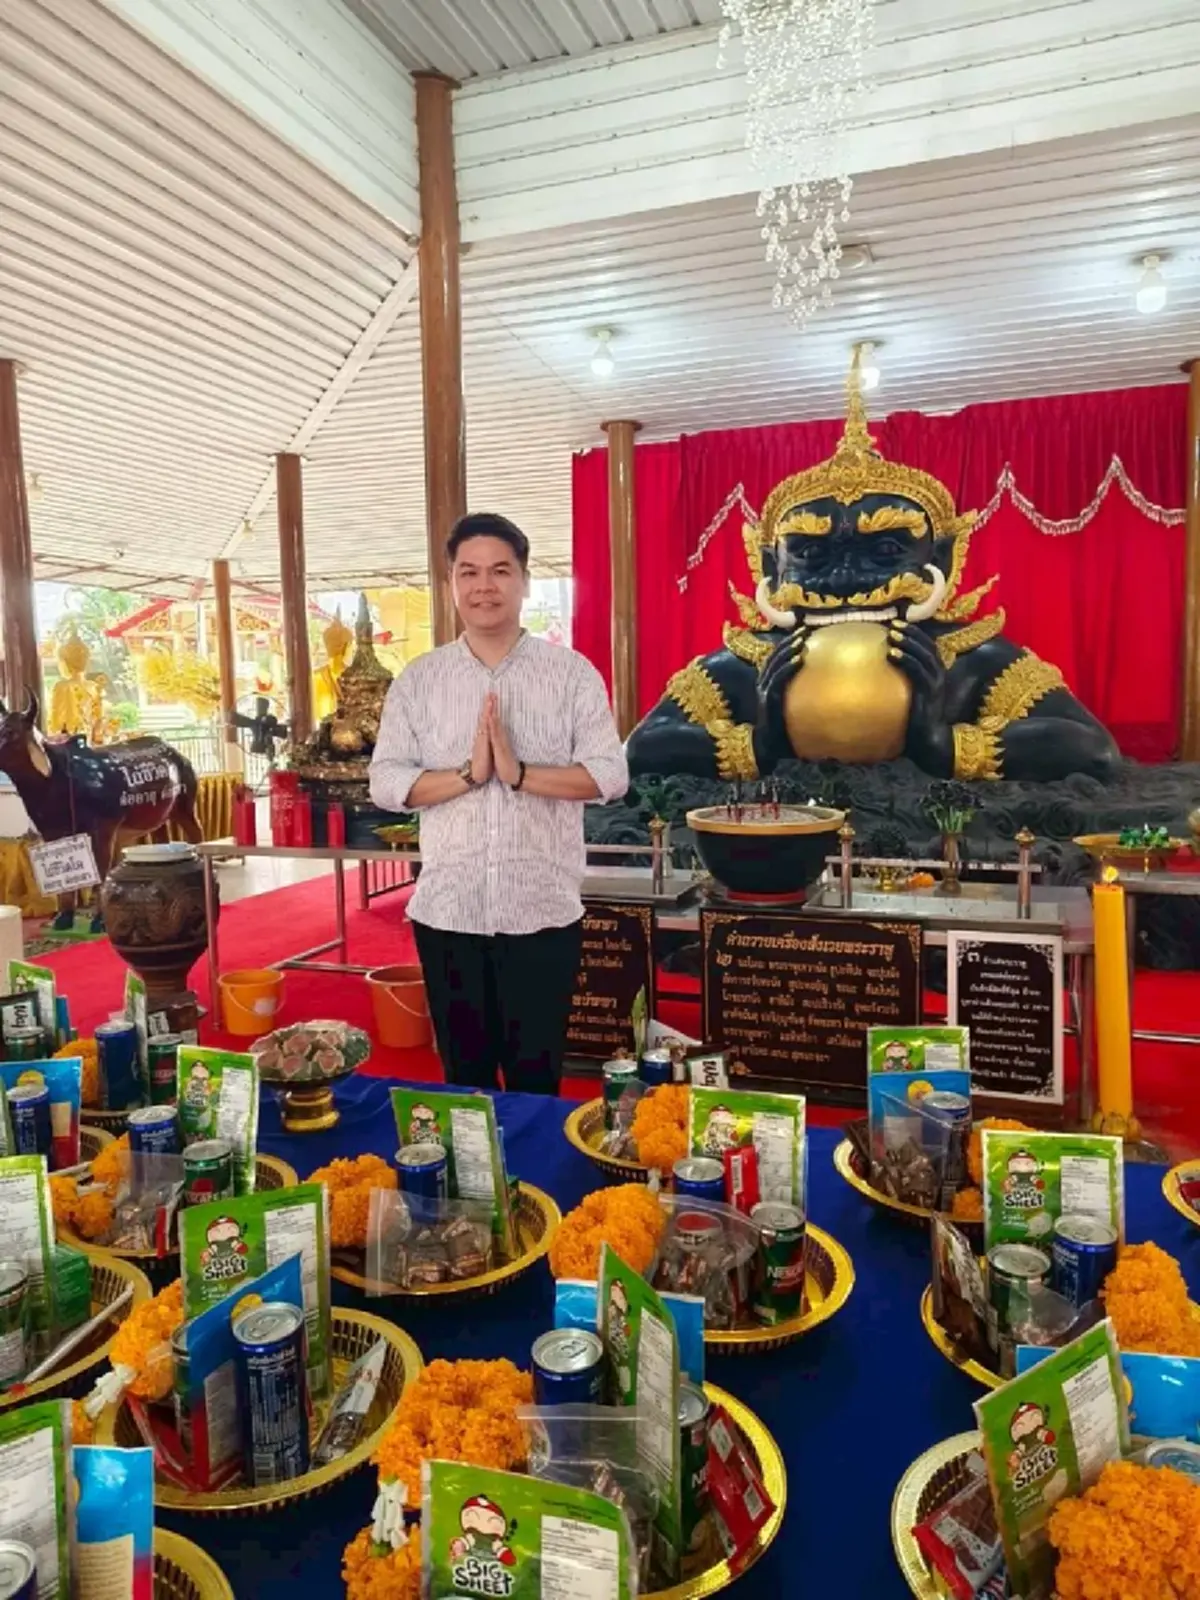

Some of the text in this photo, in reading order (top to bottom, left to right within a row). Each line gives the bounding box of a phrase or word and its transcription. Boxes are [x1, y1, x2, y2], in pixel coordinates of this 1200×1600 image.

[726, 930, 894, 961] คำถวายเครื่องสังเวยพระราหู
[1005, 1193, 1042, 1207] SHEET
[204, 1259, 246, 1280] SHEET
[212, 1254, 240, 1269] BIG
[1015, 1449, 1056, 1489] SHEET
[1022, 1446, 1048, 1470] BIG
[455, 1566, 513, 1594] SHEET
[467, 1558, 502, 1580] BIG
